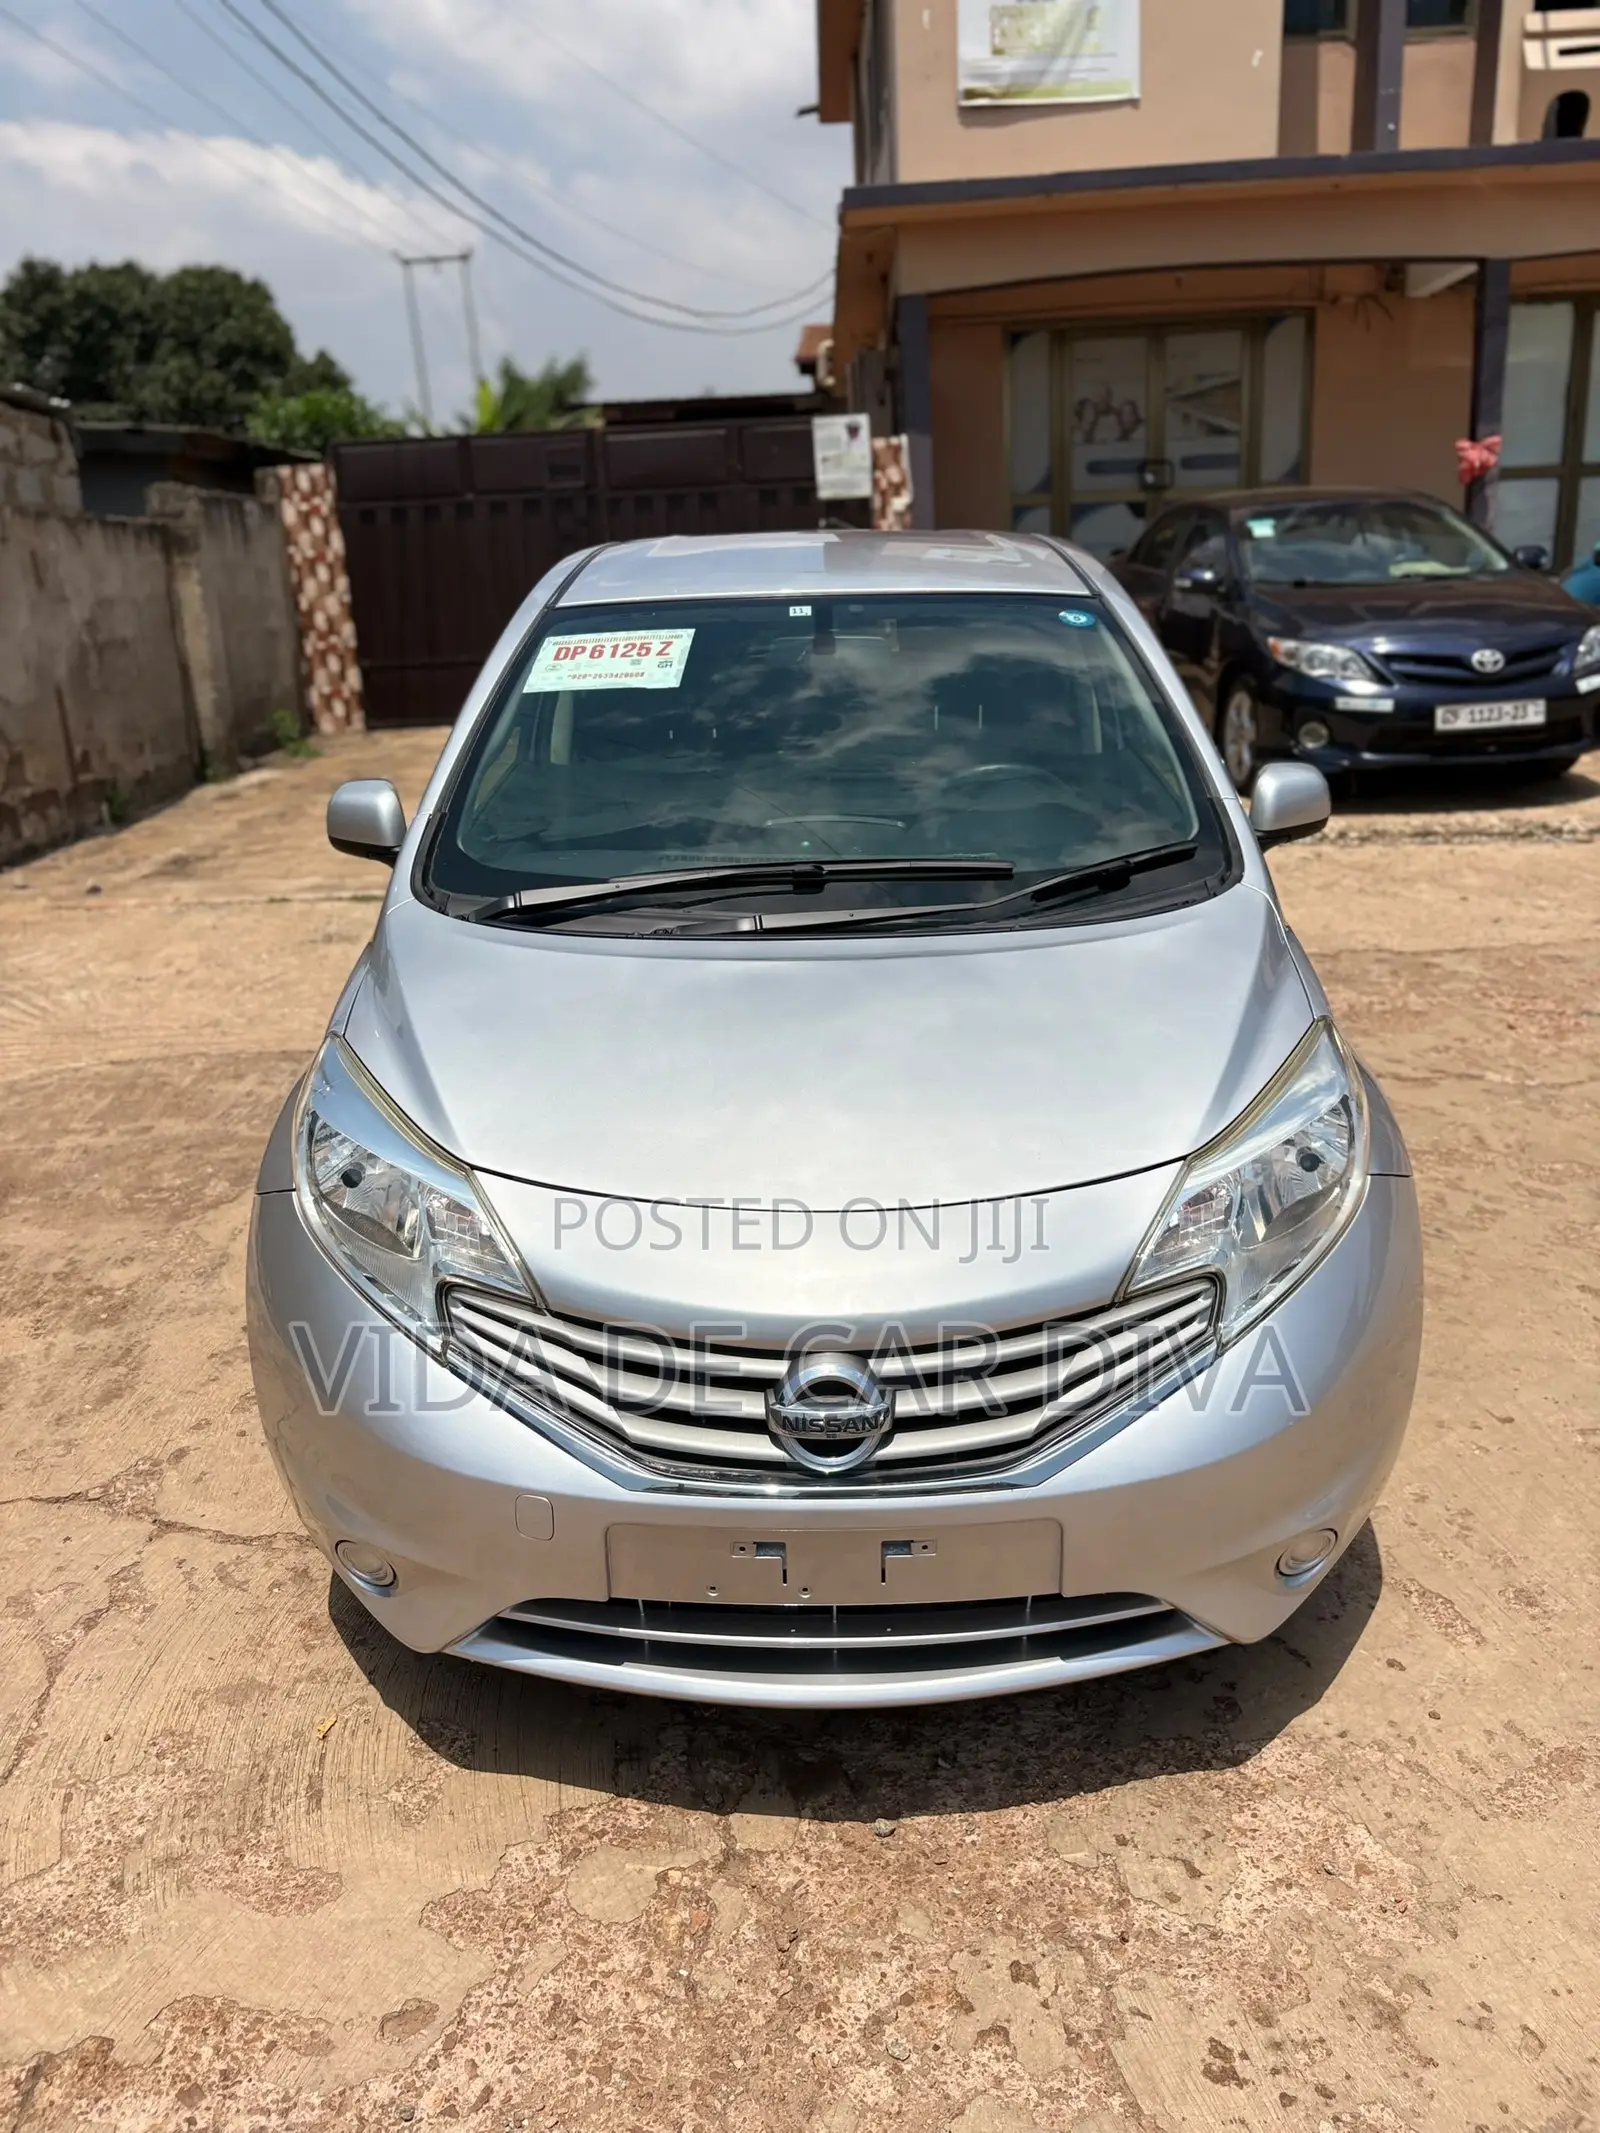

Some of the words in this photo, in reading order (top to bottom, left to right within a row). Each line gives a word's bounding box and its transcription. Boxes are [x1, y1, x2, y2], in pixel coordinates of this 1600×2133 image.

[553, 645, 587, 661] DP
[589, 641, 652, 659] 6125
[656, 641, 674, 656] Z
[782, 1414, 880, 1434] NISSAN
